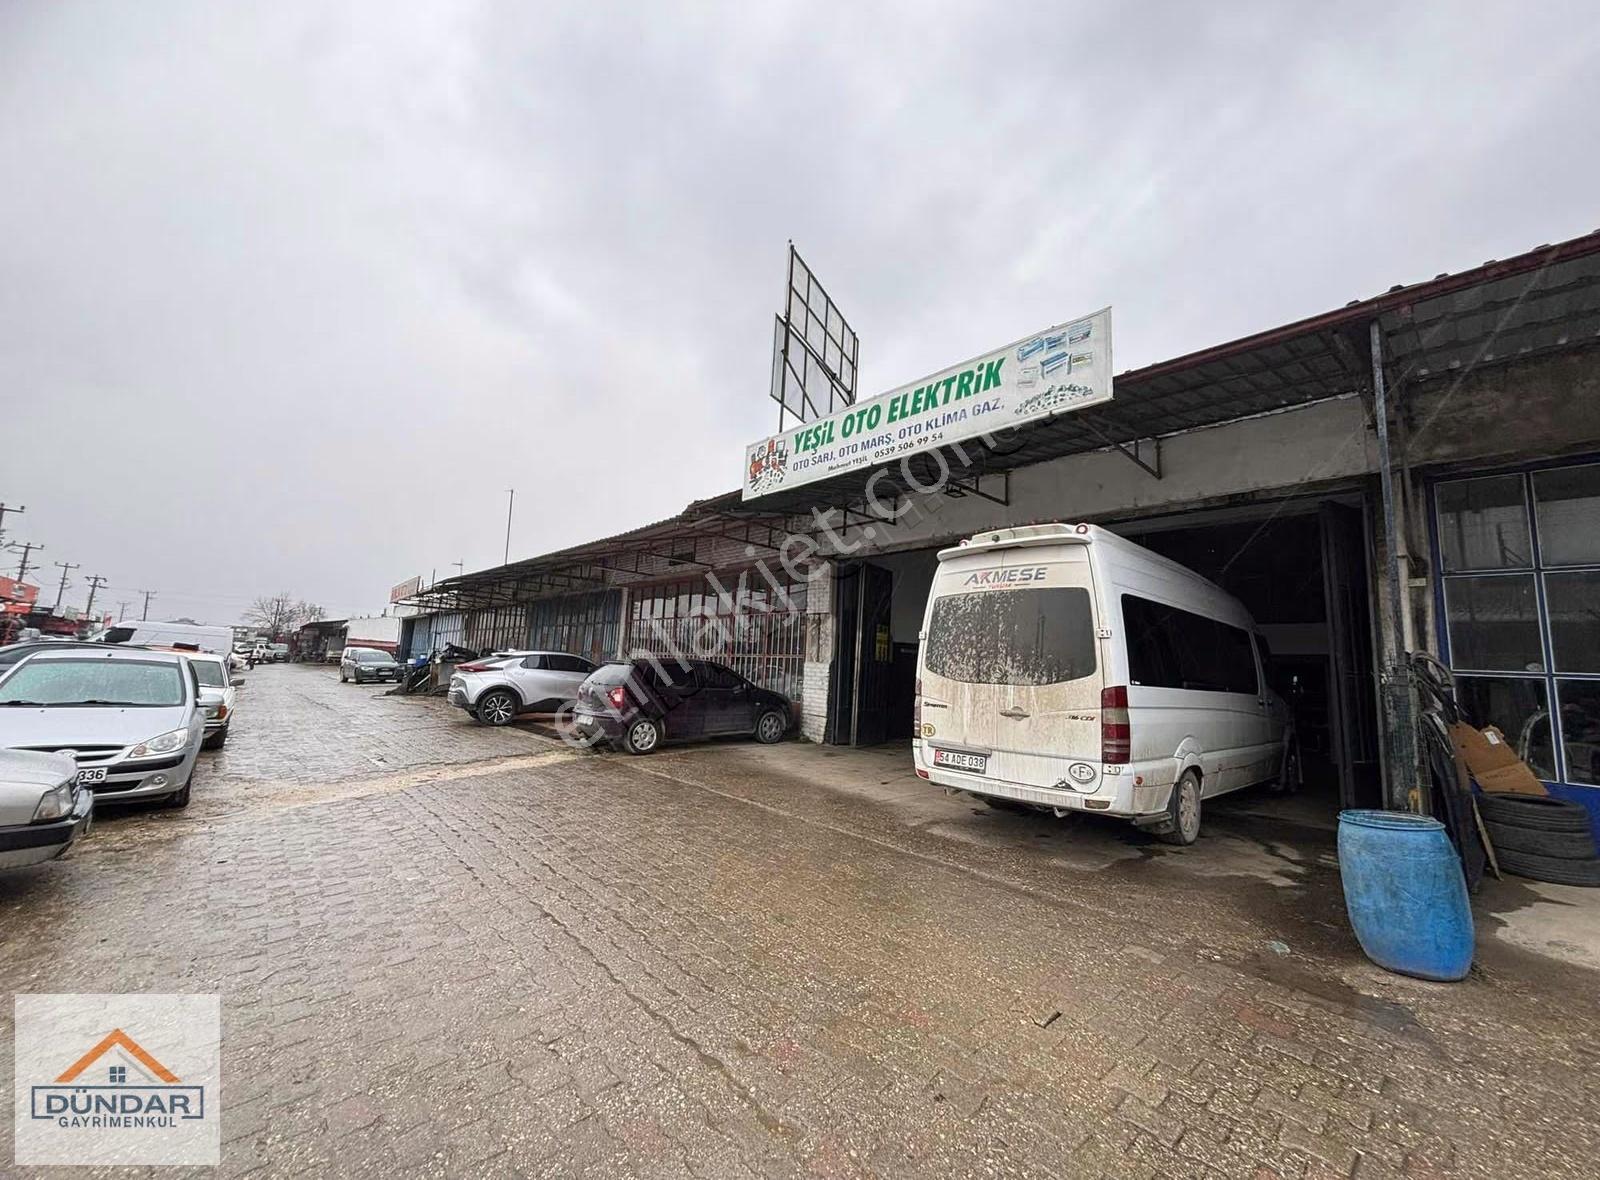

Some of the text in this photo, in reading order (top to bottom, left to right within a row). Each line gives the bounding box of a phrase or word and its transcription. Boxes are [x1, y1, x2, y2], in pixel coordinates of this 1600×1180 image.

[841, 403, 882, 439] OTO
[792, 458, 810, 472] OTO
[839, 443, 858, 458] OTO
[898, 423, 922, 440] OTO
[925, 409, 968, 432] KLİMA
[874, 446, 896, 459] 0539
[898, 441, 914, 453] 506
[917, 436, 929, 447] 99
[931, 432, 944, 443] 54
[923, 726, 933, 735] TR
[939, 752, 950, 762] 54
[968, 756, 984, 768] 038
[78, 769, 105, 781] 336
[1078, 766, 1087, 778] F
